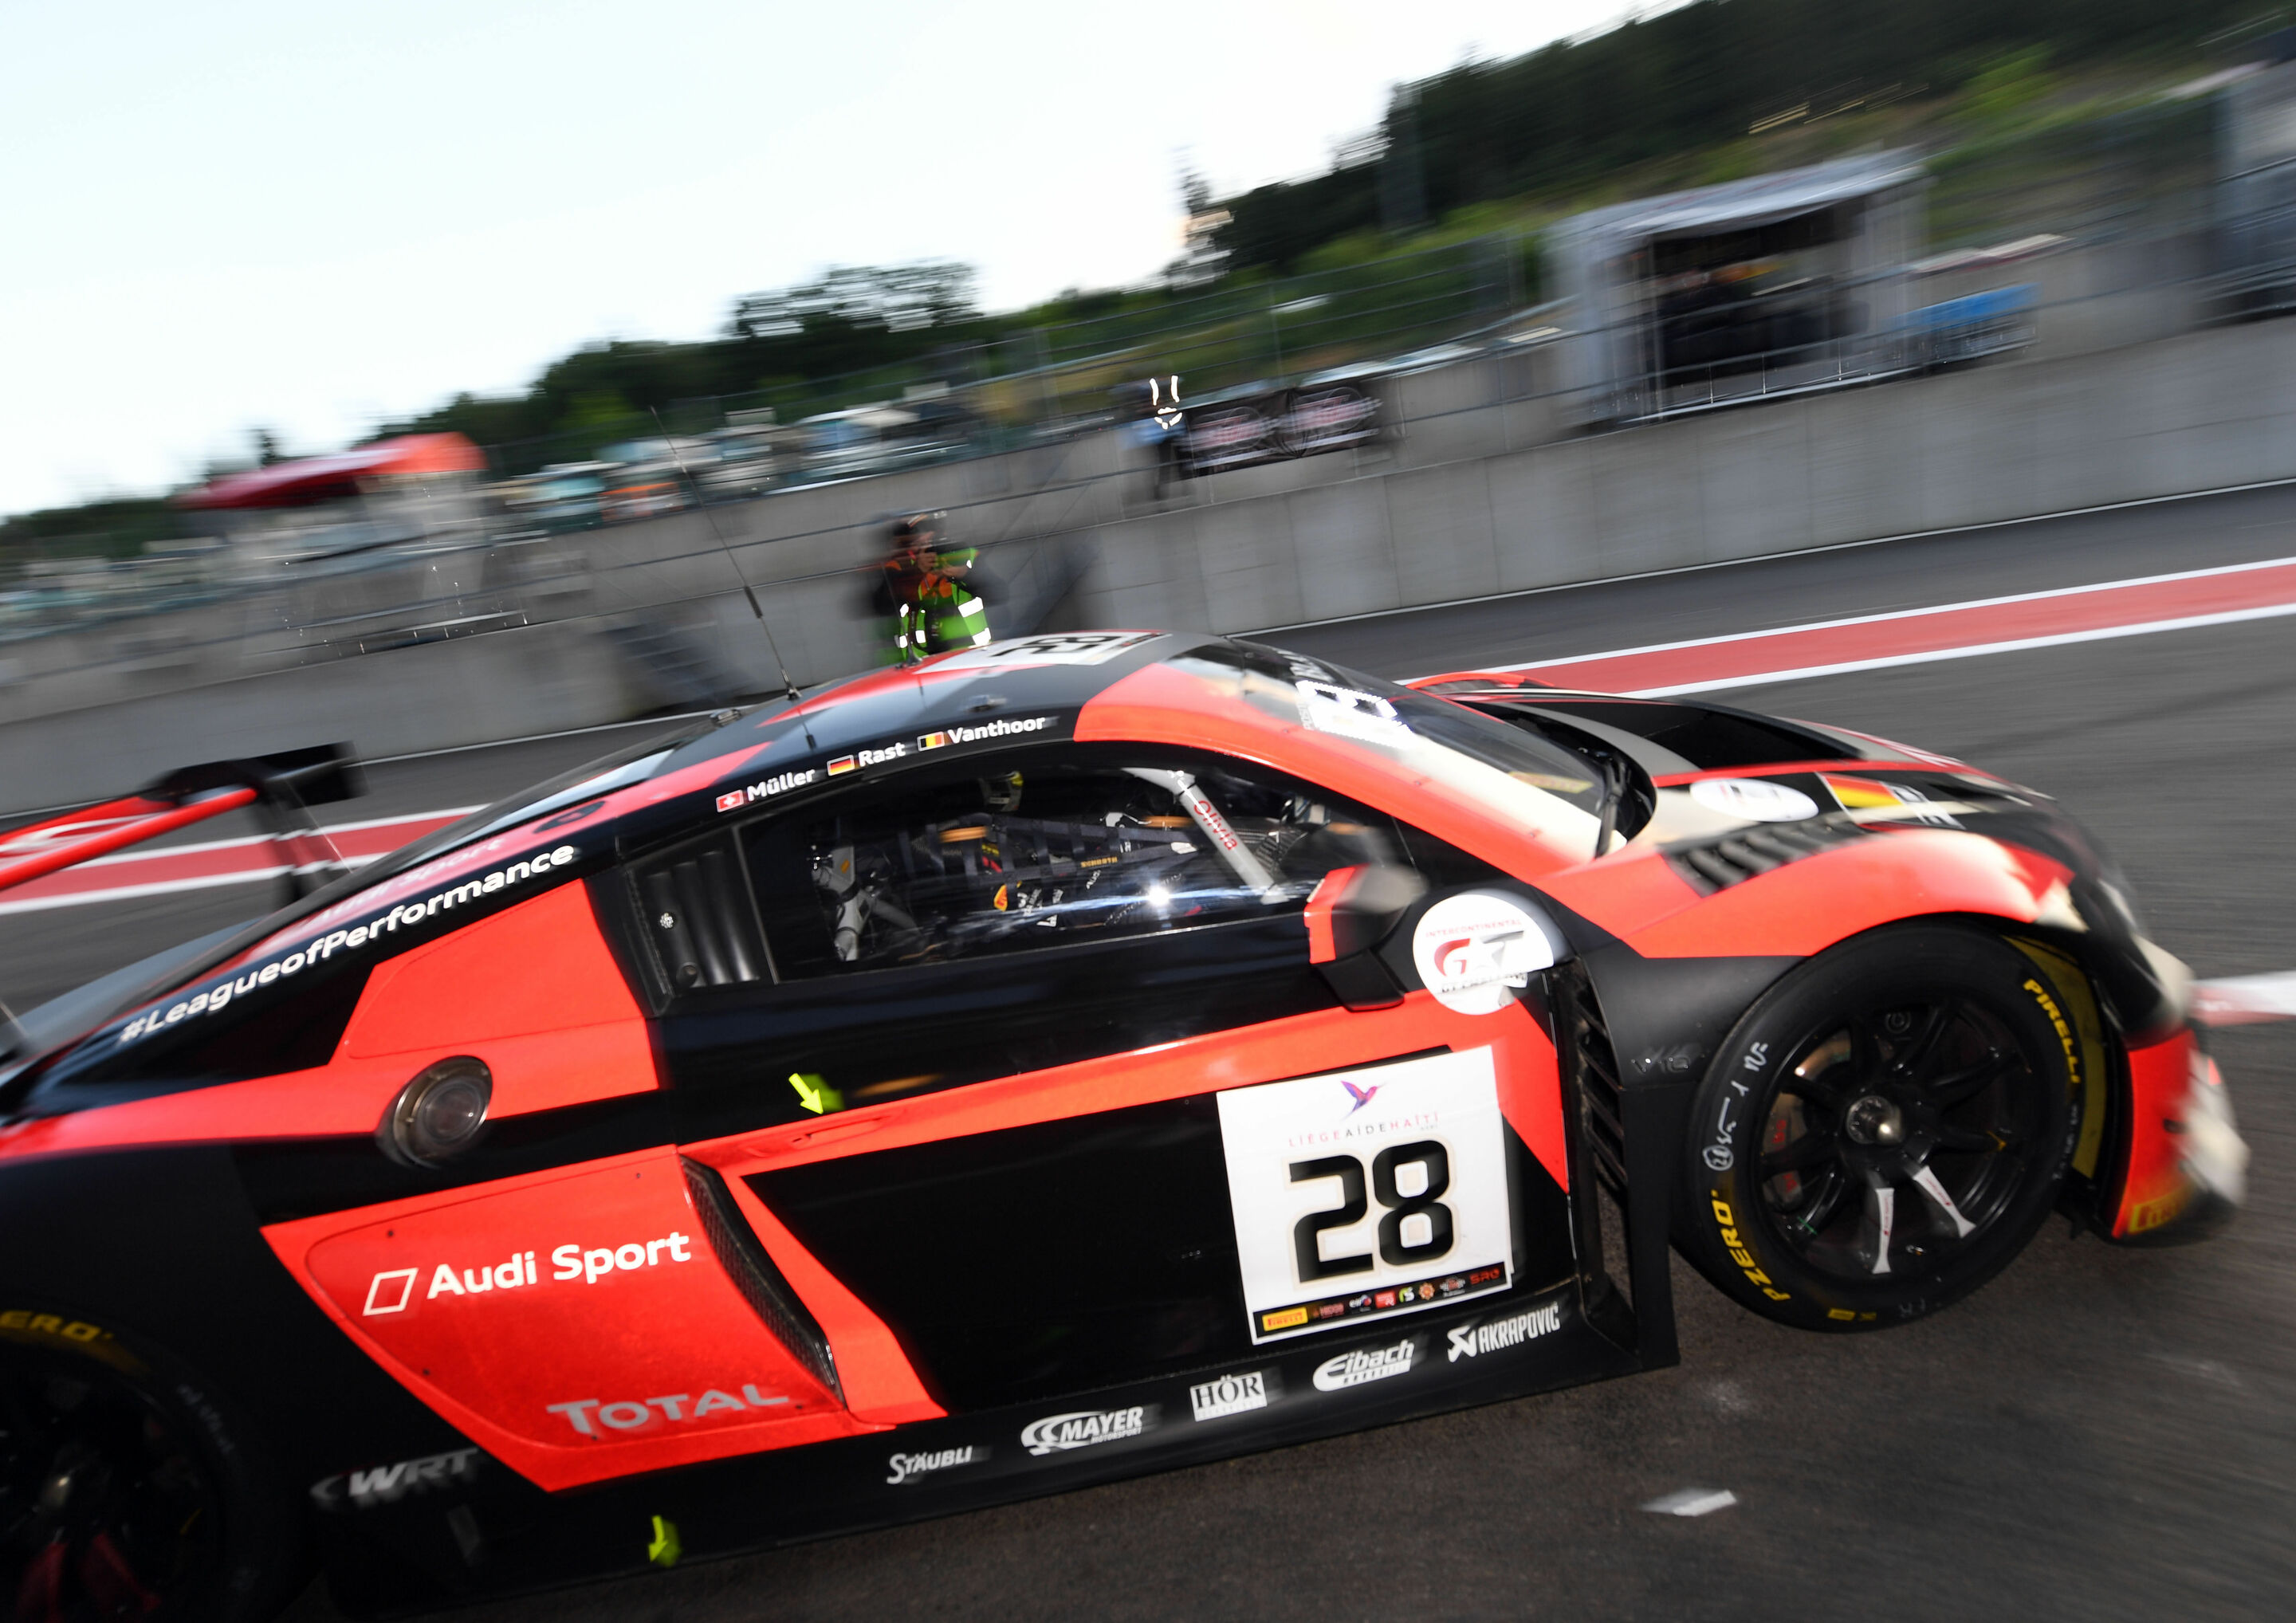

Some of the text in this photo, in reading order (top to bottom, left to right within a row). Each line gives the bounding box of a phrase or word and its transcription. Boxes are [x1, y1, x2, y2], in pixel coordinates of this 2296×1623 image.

[745, 716, 1046, 802] Müller Rast Vanthoor
[1193, 800, 1238, 851] Olivia
[120, 843, 575, 1042] #LeagueofPerformance
[2023, 978, 2081, 1084] PIRELLI
[1288, 1139, 1455, 1284] 28
[427, 1231, 692, 1300] Audi Sport
[1194, 1373, 1262, 1409] HÖR
[1312, 1339, 1415, 1392] Eibach
[546, 1383, 790, 1435] TOTAL
[1060, 1405, 1144, 1443] MAYER
[348, 1446, 478, 1497] WRT
[887, 1444, 973, 1485] STÄUBLI
